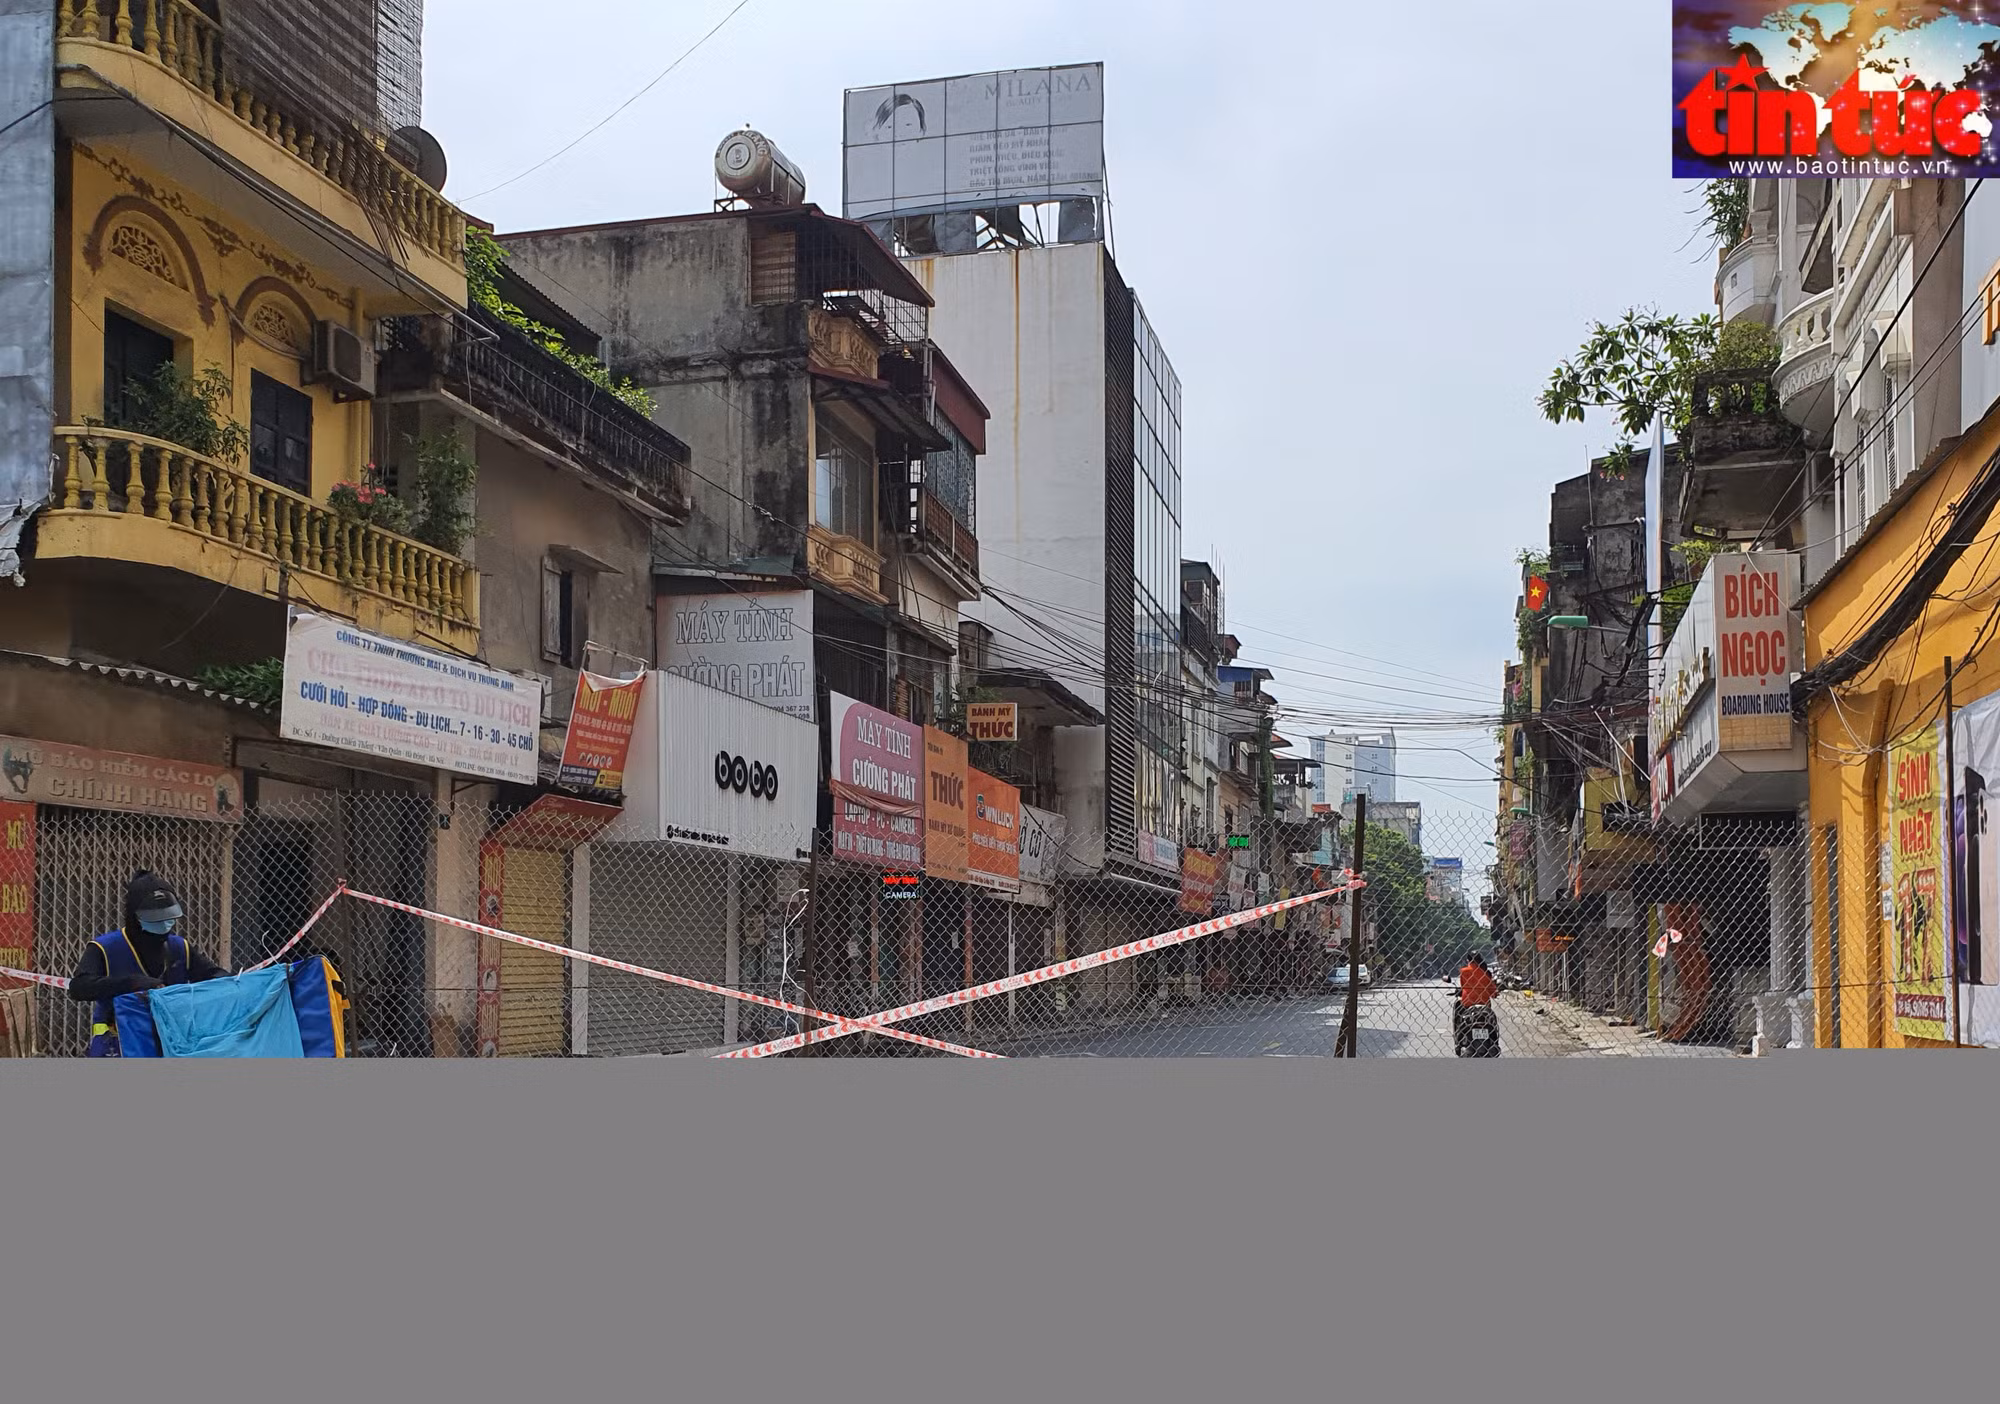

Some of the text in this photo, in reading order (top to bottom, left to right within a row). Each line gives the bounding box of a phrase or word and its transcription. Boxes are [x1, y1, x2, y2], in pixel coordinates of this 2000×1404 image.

[985, 73, 1092, 100] MILANA
[1724, 563, 1779, 619] BÍCH
[676, 597, 794, 644] MÁY TÍNH
[336, 630, 514, 692] CÔNG TY TNHH THƯƠNG MẠI & DỊCH VỤ TRUNG ANH
[747, 655, 805, 698] PHÁT
[1721, 630, 1785, 686] NGỌC
[300, 681, 327, 704] CƯỚI
[330, 685, 348, 709] HỎI
[358, 695, 379, 720] HỢP
[381, 698, 407, 723] ĐỒNG
[416, 710, 429, 727] DU
[460, 720, 465, 737] 7
[474, 724, 484, 740] 16
[490, 728, 500, 744] 30
[507, 731, 517, 747] 45
[971, 707, 994, 717] BÁNH
[1721, 692, 1789, 716] BOARDING HOUSE
[857, 713, 911, 759] MÁY TÍNH
[969, 718, 1014, 739] THỨC
[50, 751, 94, 771] BẢO
[101, 757, 148, 778] HIỂM
[152, 764, 190, 782] CÁC
[715, 750, 778, 801] bobo
[852, 756, 916, 802] CƯỜNG PHÁT
[49, 777, 207, 813] CHÍNH HÃNG
[931, 772, 964, 811] THỨC
[844, 802, 871, 825] LAPTOP
[876, 811, 886, 829] PC
[885, 891, 917, 899] CAMERA
